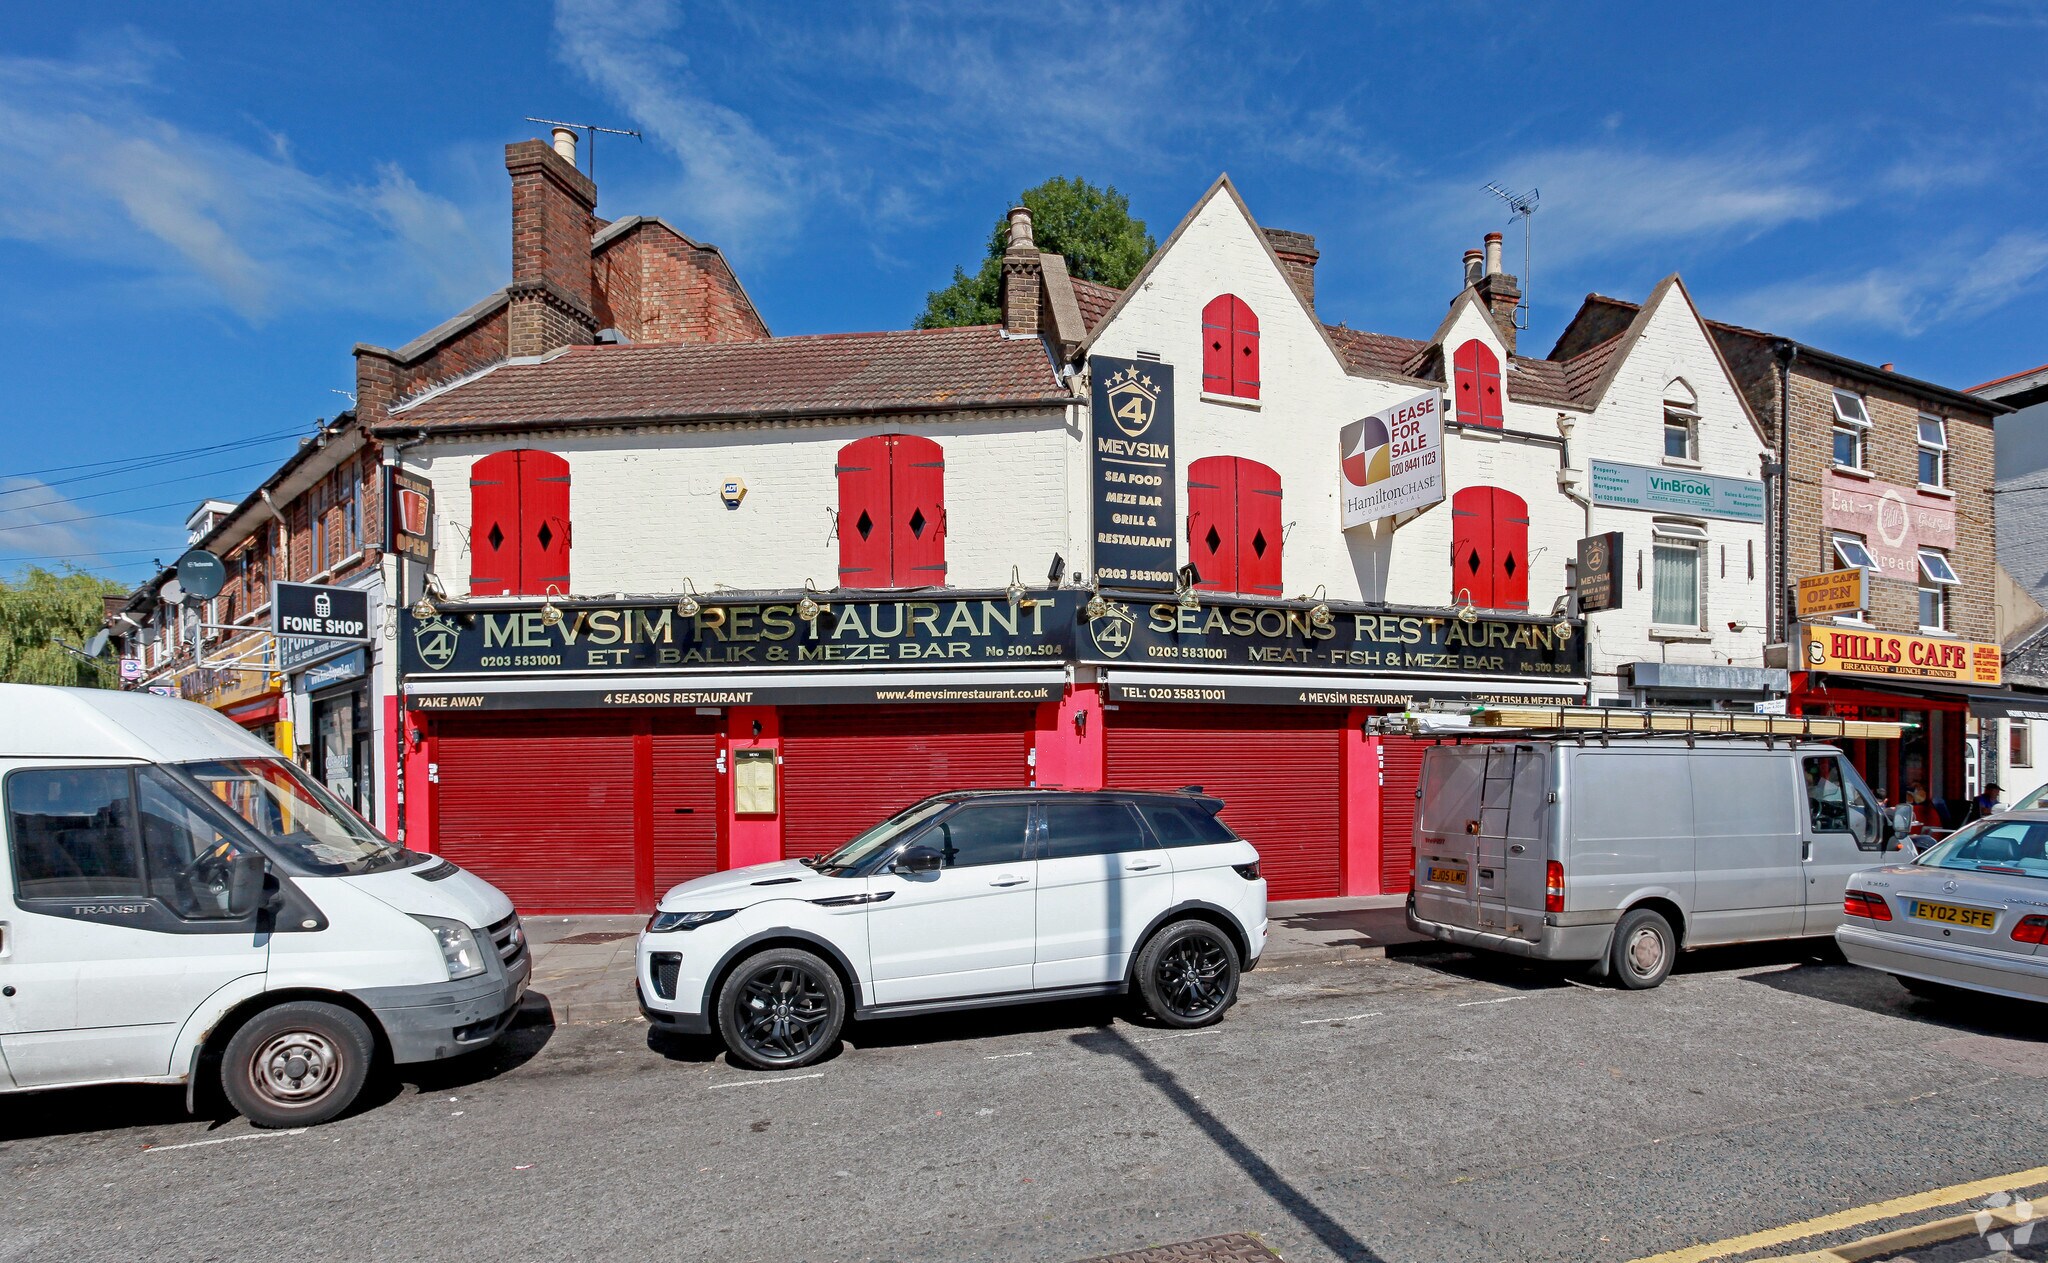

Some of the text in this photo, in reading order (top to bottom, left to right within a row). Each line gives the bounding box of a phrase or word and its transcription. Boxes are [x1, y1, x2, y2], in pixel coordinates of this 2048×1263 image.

[1118, 397, 1146, 424] 4
[1392, 398, 1434, 427] LEASE
[1391, 420, 1420, 442] FOR
[1098, 438, 1169, 459] MEVSIM
[1391, 434, 1427, 458] SALE
[1392, 451, 1436, 477] 020 8441 1123
[1105, 471, 1162, 486] SEA FOOD
[1650, 477, 1711, 496] VinBrook
[1106, 492, 1162, 507] MEZE BAR
[1347, 475, 1436, 513] HamiltonCHASE
[1831, 489, 1855, 513] Eat
[1362, 494, 1421, 516] COMMERCIAL
[1112, 513, 1157, 527] GRILL &
[396, 533, 429, 557] OPEN
[1098, 533, 1172, 548] RESTAURANT
[1590, 553, 1601, 565] 4
[1870, 547, 1915, 573] Bread
[1098, 568, 1174, 583] 0203 5831001
[1581, 572, 1610, 586] MEVSIM
[1800, 572, 1860, 589] HILLS CAFE
[1807, 585, 1851, 604] OPEN
[1808, 605, 1826, 613] DAYS
[283, 616, 363, 635] FONE SHOP
[483, 598, 1055, 648] MEVSIM RESTAURANT
[1148, 604, 1337, 641] SEASONS
[1097, 619, 1127, 647] 4
[423, 634, 451, 659] 4
[588, 648, 629, 665] ET
[659, 646, 756, 664] BALIK
[766, 646, 789, 661] &
[798, 643, 890, 661] MEZE
[899, 641, 971, 659] BAR
[986, 644, 1062, 657] No 500-504
[1149, 646, 1227, 659] 0203 5831001
[1830, 633, 1966, 669] HILLS CAFE
[481, 654, 561, 667] 0203 5831001
[1248, 646, 1312, 664] MEAT
[1331, 649, 1380, 666] FISH
[1385, 652, 1401, 665] &
[1405, 652, 1460, 669] MEZE
[1463, 655, 1504, 671] BAR
[1843, 663, 1889, 673] BREAKFAST
[1896, 667, 1921, 675] LUNCH
[1927, 670, 1955, 678] DINNER
[418, 696, 484, 707] TAKE AWAY
[604, 691, 753, 704] 4 SEASONS RESTAURANT
[876, 688, 1049, 700] www.4mevsimrestaurant.co.uk
[1121, 687, 1226, 700] TEL: 020 35831001
[1299, 693, 1306, 703] 4
[1350, 694, 1413, 705] RESTAURANT
[1503, 696, 1521, 704] FISH
[1523, 696, 1530, 704] &
[1531, 696, 1554, 705] MEZE
[1556, 697, 1573, 706] BAR
[72, 904, 149, 915] TRANSIT
[1918, 903, 1992, 927] EY02 SFE
